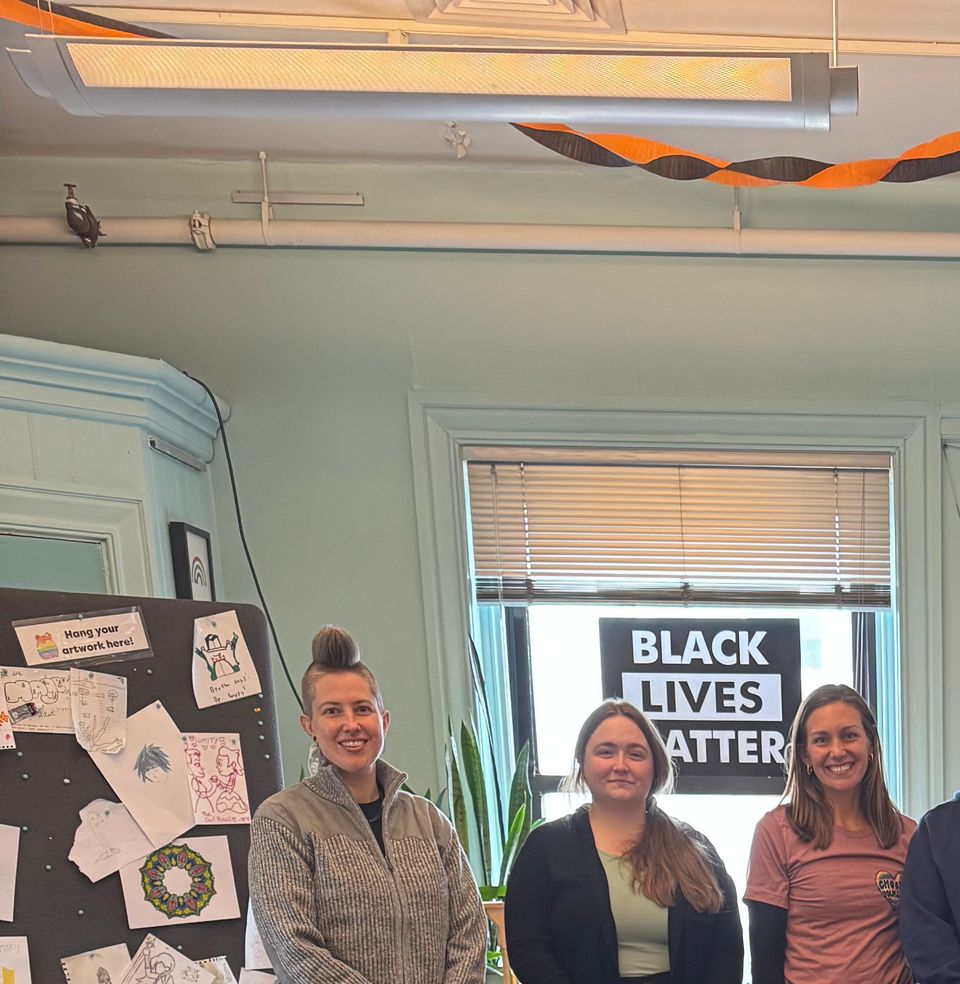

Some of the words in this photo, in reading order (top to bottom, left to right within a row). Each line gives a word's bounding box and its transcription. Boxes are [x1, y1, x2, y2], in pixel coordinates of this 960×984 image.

[62, 641, 106, 655] artwork
[106, 636, 134, 649] here!
[64, 629, 94, 639] Hang
[95, 625, 119, 637] your
[631, 629, 769, 666] BLACK
[641, 680, 763, 714] LIVES
[665, 729, 786, 764] ATTER
